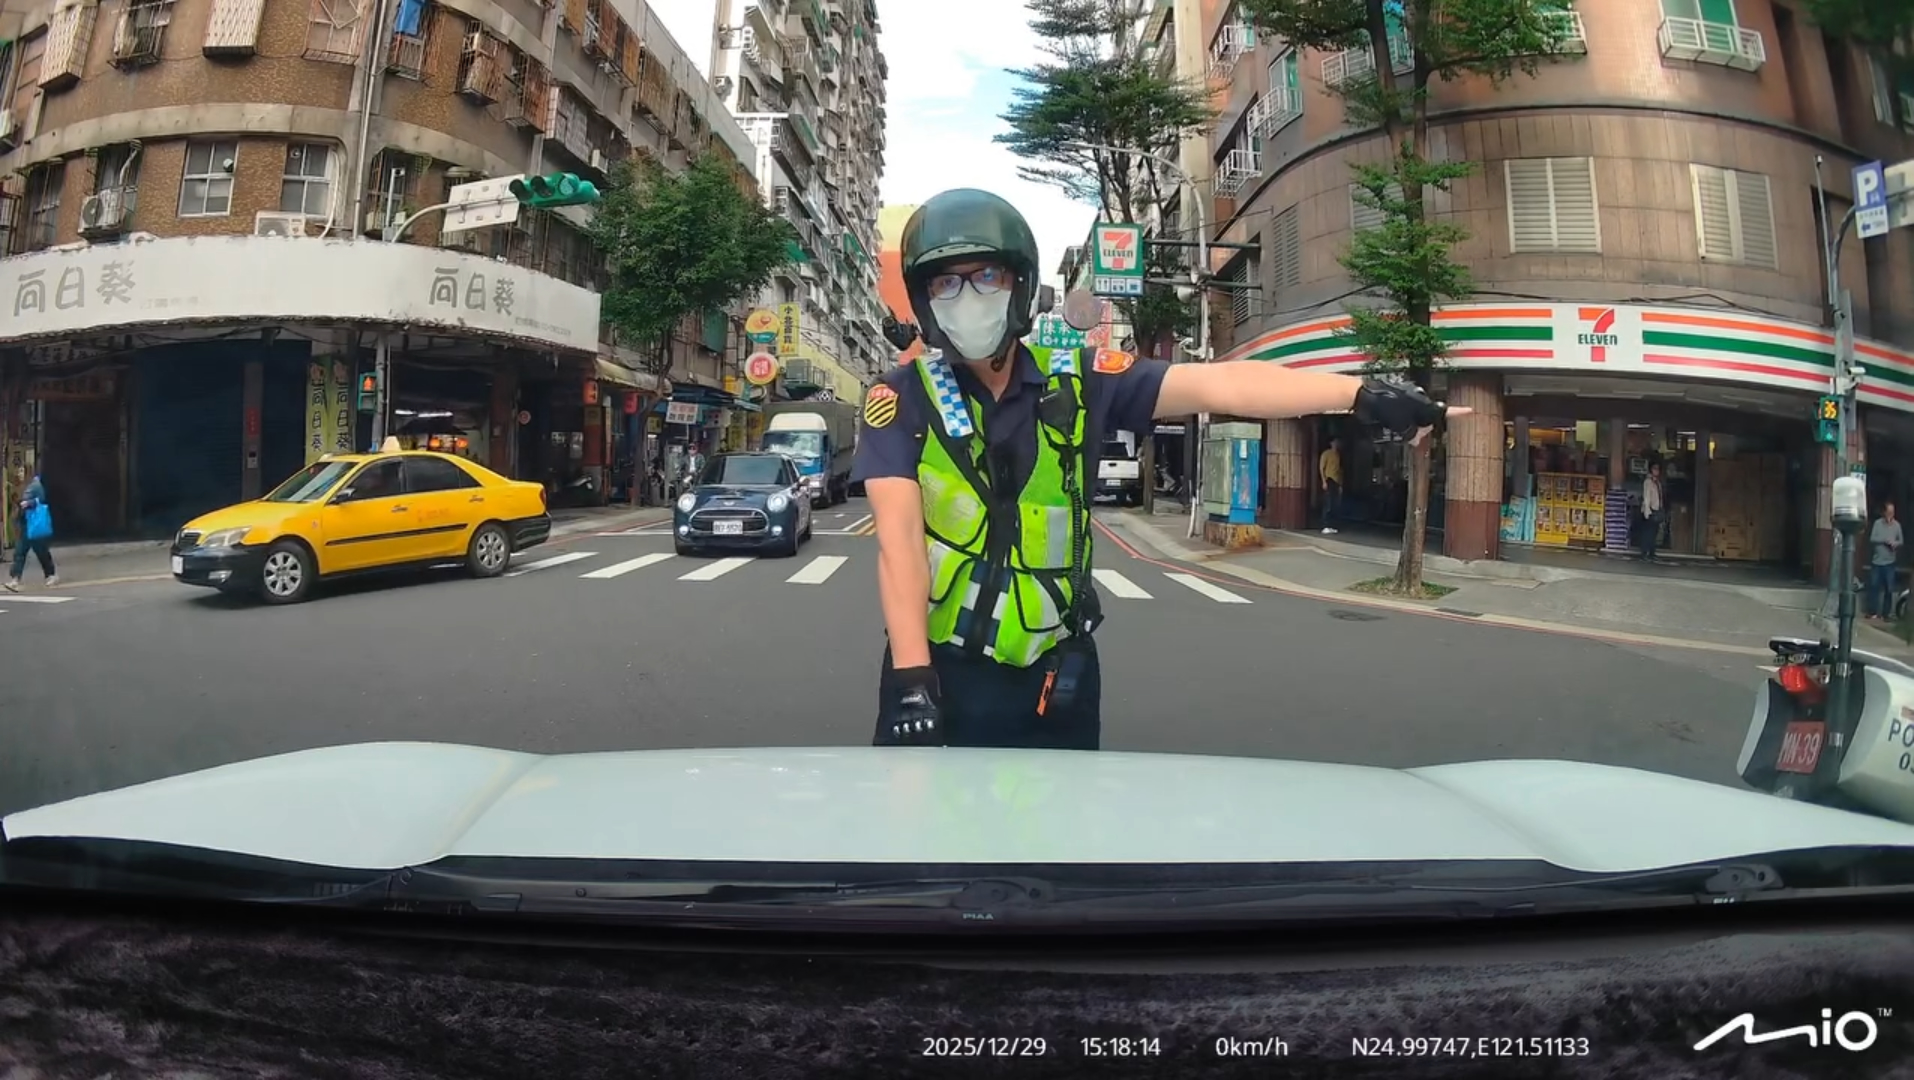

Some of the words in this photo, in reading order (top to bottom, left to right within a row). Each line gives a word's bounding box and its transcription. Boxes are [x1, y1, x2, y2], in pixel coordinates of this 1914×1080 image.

[1856, 169, 1879, 207] P
[1104, 231, 1132, 269] 7
[14, 259, 136, 317] 向日葵
[428, 267, 515, 316] 向日葵
[1578, 307, 1615, 362] 7
[311, 387, 324, 452] 向日葵
[336, 386, 349, 450] 向日葵
[1887, 717, 1914, 748] PO
